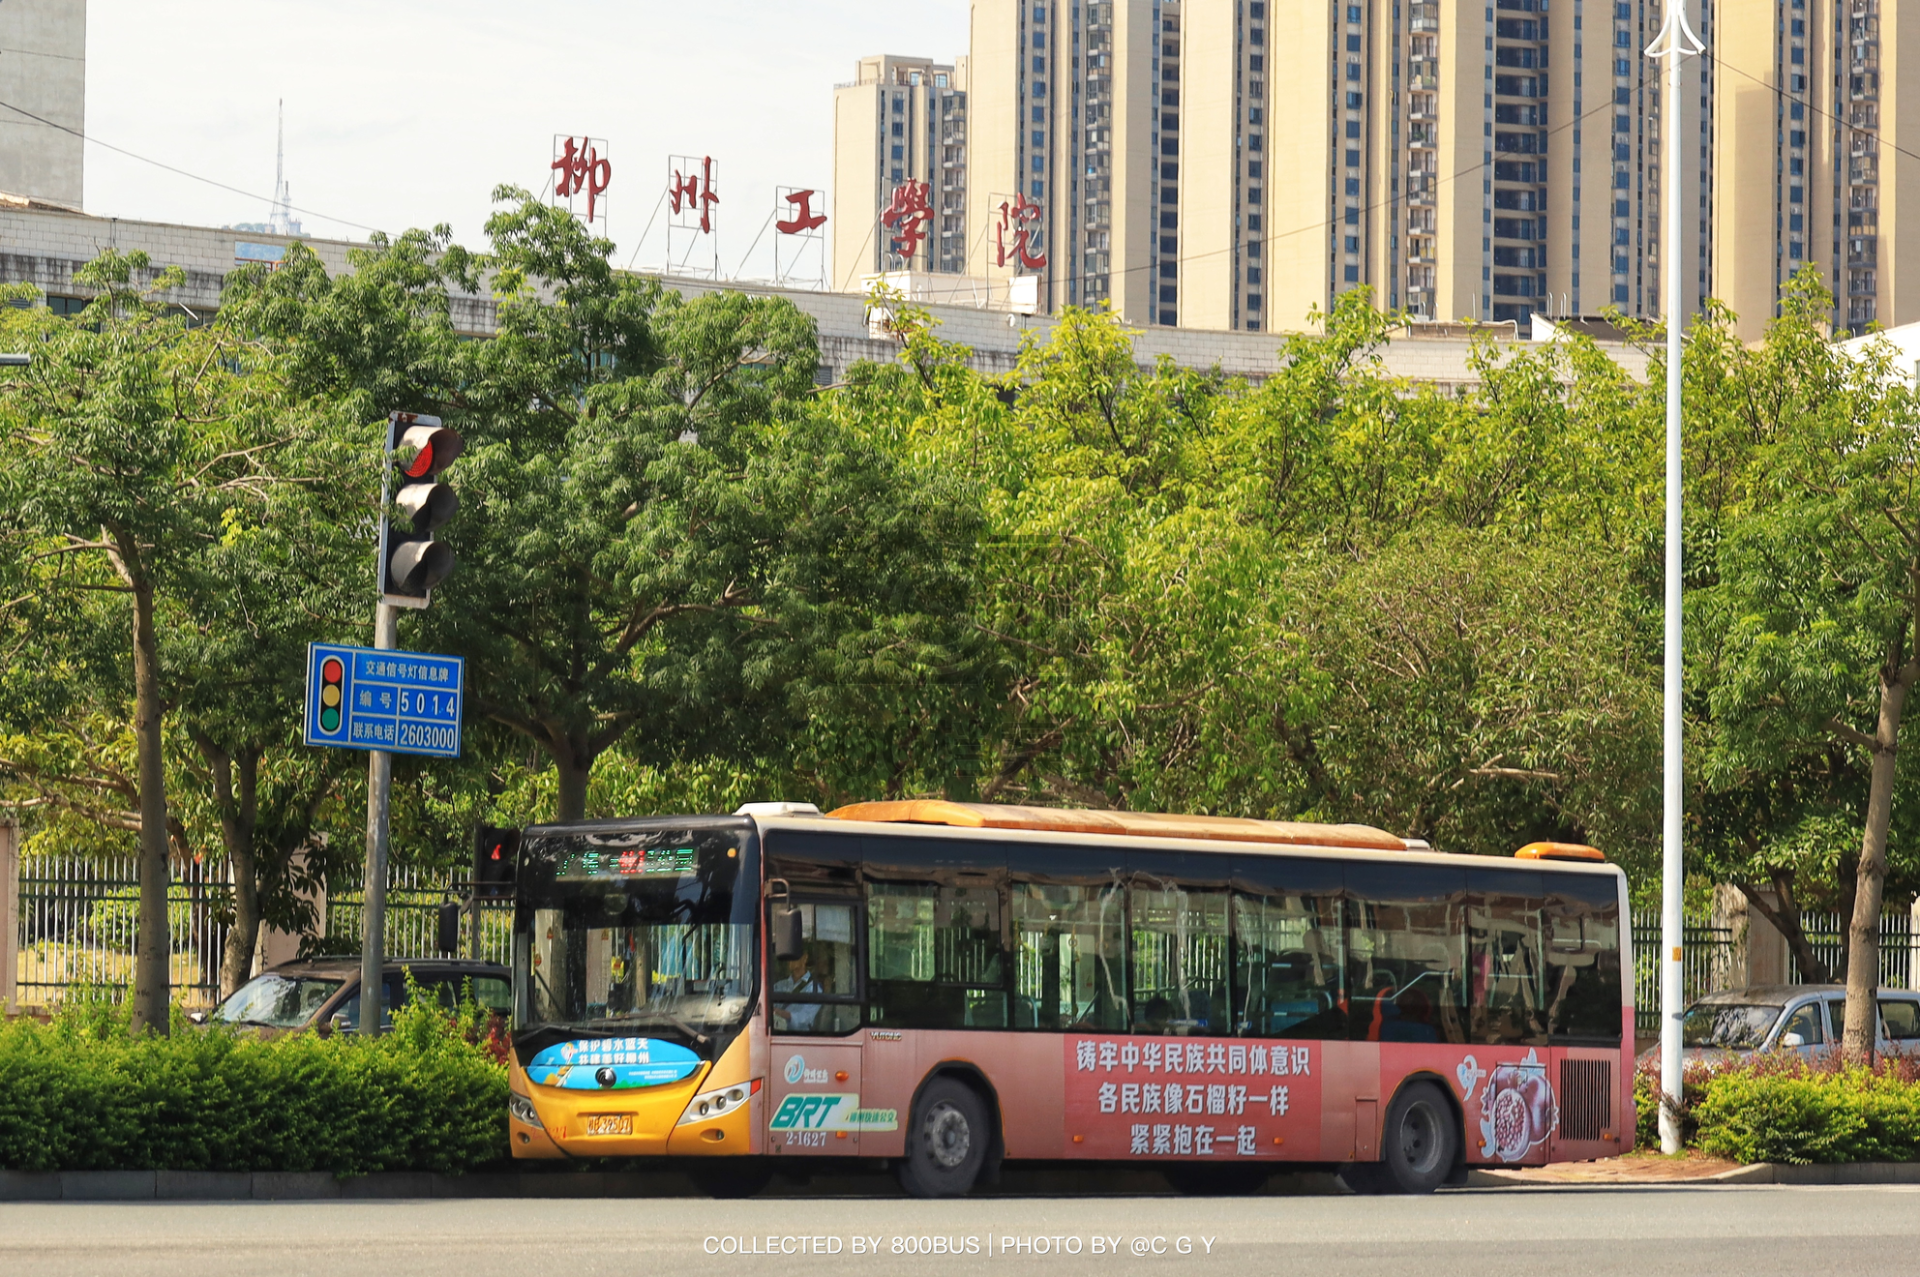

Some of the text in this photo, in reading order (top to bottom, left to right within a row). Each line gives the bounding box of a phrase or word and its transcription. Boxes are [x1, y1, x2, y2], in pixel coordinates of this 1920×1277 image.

[366, 660, 449, 682] 交通信号灯信息牌
[360, 690, 455, 717] 编号 5014
[353, 721, 455, 749] 联系电话 2603000
[1076, 1040, 1311, 1076] 铸牢中华民族共同体意识
[771, 1096, 842, 1128] BRT
[1098, 1081, 1290, 1116] 各民族像石榴籽一样
[1130, 1123, 1256, 1156] 紧紧抱在一起
